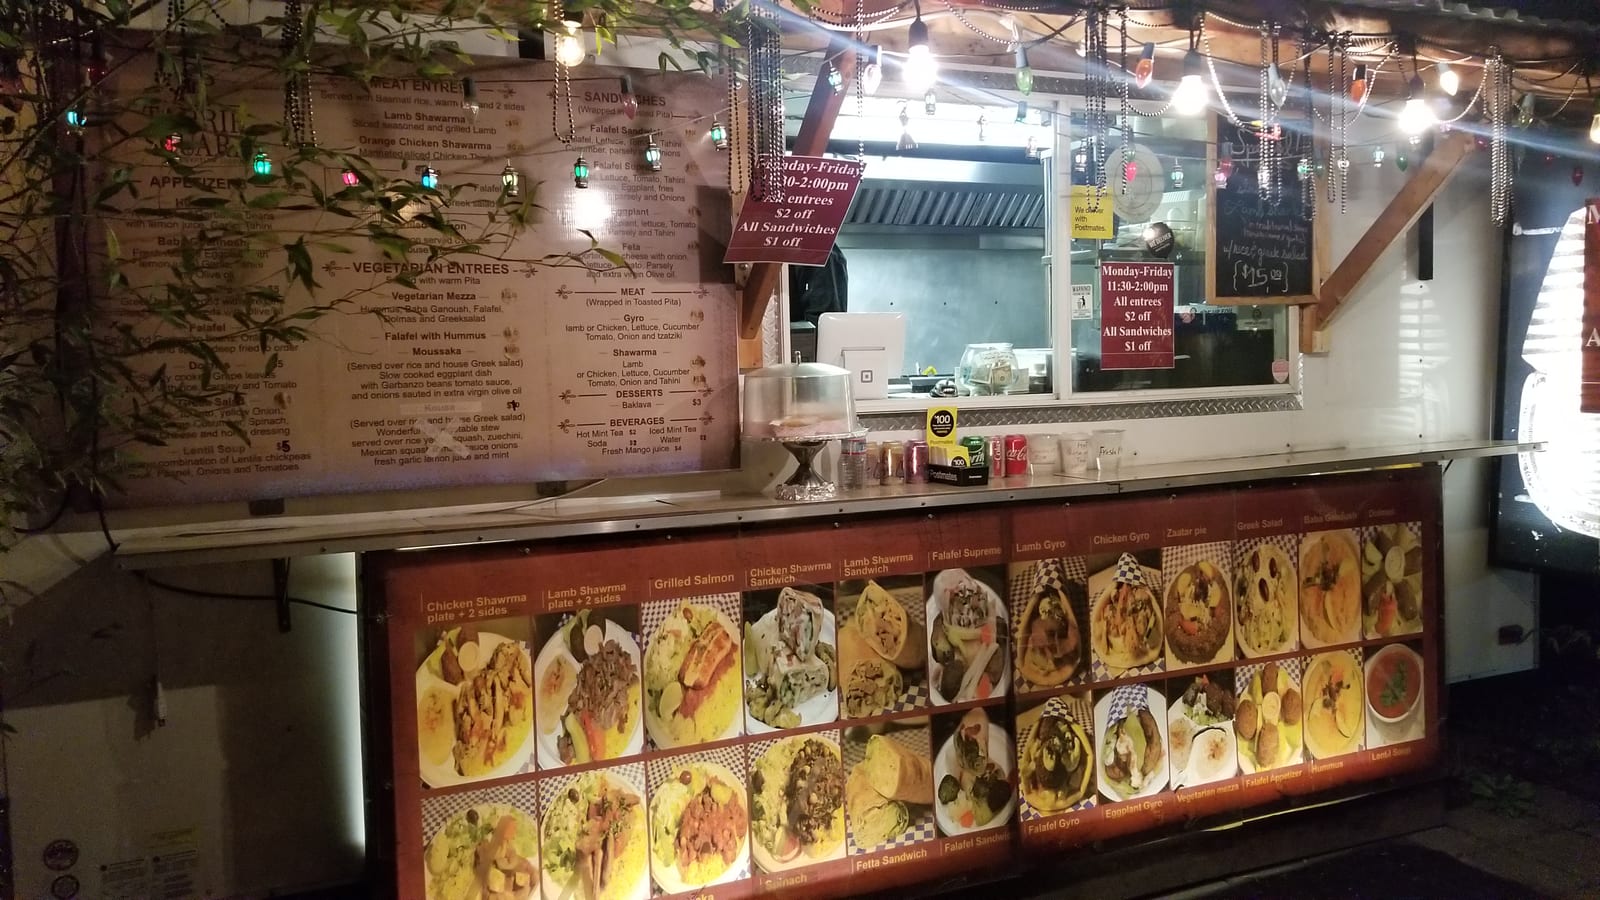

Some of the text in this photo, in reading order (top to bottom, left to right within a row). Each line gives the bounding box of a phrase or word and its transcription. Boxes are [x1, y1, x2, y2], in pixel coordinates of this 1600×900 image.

[384, 111, 466, 123] Lamb Shawarma
[427, 124, 497, 135] and Lamb
[590, 124, 620, 134] Falafel
[360, 135, 492, 150] Orange Chicken Shawarma
[787, 195, 834, 206] entrees
[775, 208, 815, 219] $2 off
[738, 221, 836, 235] All Sandwiches
[763, 236, 802, 247] $1 off
[353, 262, 509, 274] VEGETARIAN ENTREES
[1102, 265, 1173, 279] Monday-Friday
[419, 277, 436, 285] with
[464, 277, 481, 285] Pita
[621, 288, 645, 296] MEAT
[1107, 281, 1168, 294] 11:30-2:00pm
[392, 292, 476, 302] Vegetarian Mezza
[1114, 296, 1162, 307] All entrees
[586, 299, 623, 308] (Wrapped
[634, 299, 663, 307] Toasted
[664, 299, 682, 307] Pita)
[419, 315, 435, 323] and
[623, 314, 645, 324] Gyro
[1125, 311, 1151, 322] $2 off
[662, 323, 700, 331] Cucumber
[1103, 326, 1172, 337] All Sandwiches
[385, 331, 486, 341] Falafel with Hummus
[617, 333, 640, 341] Onion
[413, 347, 461, 356] Moussaka
[1125, 341, 1151, 351] $1 off
[613, 349, 657, 357] Shawarma
[347, 359, 496, 372] (Served over rice and house Greek
[379, 368, 492, 379] Slow cooked dish
[652, 368, 690, 377] Cucumber
[361, 378, 483, 389] with beans tomato
[620, 377, 681, 386] Onion and Tahini
[352, 386, 522, 399] and onions in olive oil
[616, 389, 663, 398] DESSERTS
[622, 401, 652, 409] Baklava
[474, 414, 498, 422] Greek
[610, 416, 665, 427] BEVERAGES
[576, 425, 697, 439] Hot Mint Tea Mint Tea
[587, 440, 608, 448] Soda
[1093, 532, 1150, 545] Chicken Gyro
[1016, 539, 1066, 552] Lamb Gyro
[932, 546, 1002, 561] Falafel Supreme
[844, 553, 914, 568] Lamb Shawrma
[750, 561, 832, 577] Chicken Shawrma
[844, 564, 889, 577] Sandwich
[654, 573, 735, 590] Grilled Salmon
[750, 574, 795, 587] Sandwich
[548, 583, 627, 599] Lamb Shawrma
[427, 593, 527, 612] Chicken Shawrma
[548, 597, 574, 610] plate
[586, 595, 592, 605] 2
[594, 592, 621, 604] sides
[427, 612, 454, 625] plate
[469, 609, 475, 618] 2
[478, 605, 507, 618] sides
[1311, 761, 1344, 774] Hummus
[1246, 769, 1303, 788] Falafel Appetizer
[1177, 788, 1215, 804] Vegetarian
[1105, 799, 1163, 820] Eggplant Gyro
[1028, 817, 1080, 835] Falafel Gyro
[944, 840, 974, 853] Falafel
[856, 849, 927, 872] Fetta Sandwich
